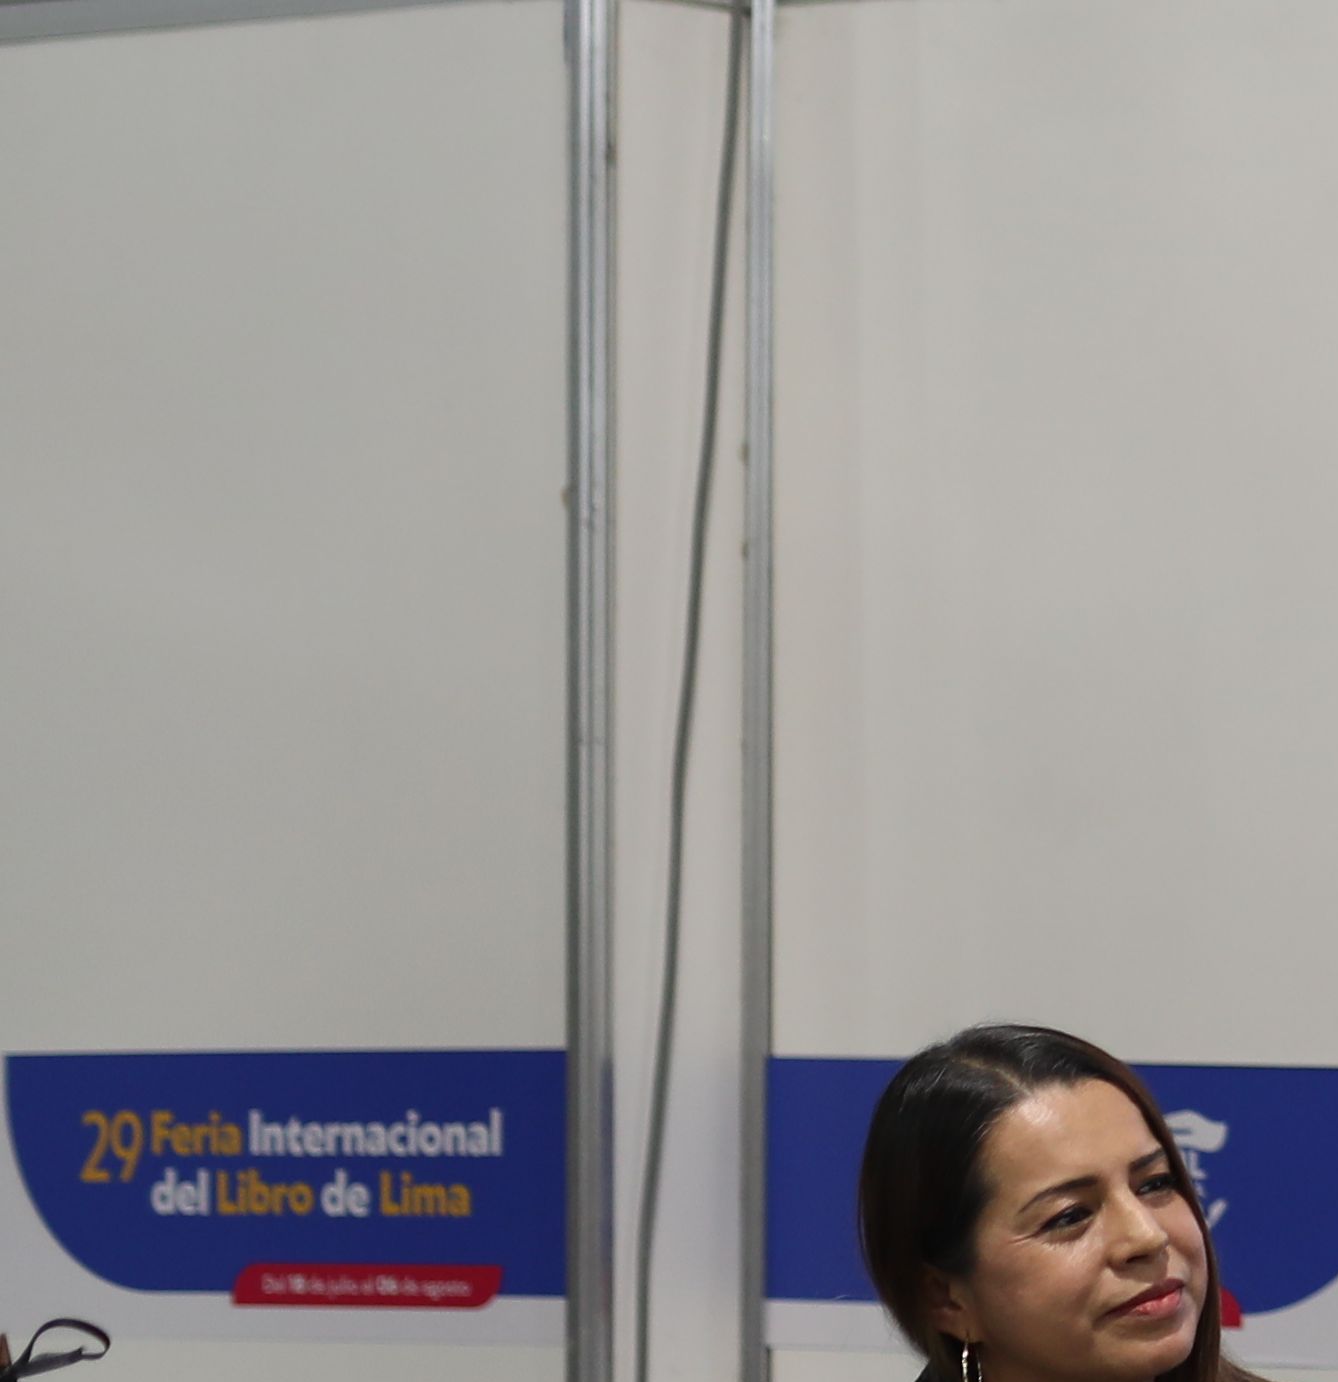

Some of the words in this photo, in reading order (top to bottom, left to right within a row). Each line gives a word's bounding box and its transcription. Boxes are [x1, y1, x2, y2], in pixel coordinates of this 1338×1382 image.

[80, 1111, 142, 1182] 29
[151, 1111, 241, 1156] Feria
[248, 1109, 503, 1157] Internacional
[151, 1168, 209, 1215] del
[217, 1170, 313, 1214] Libro
[321, 1170, 370, 1216] de
[380, 1171, 470, 1216] Lima
